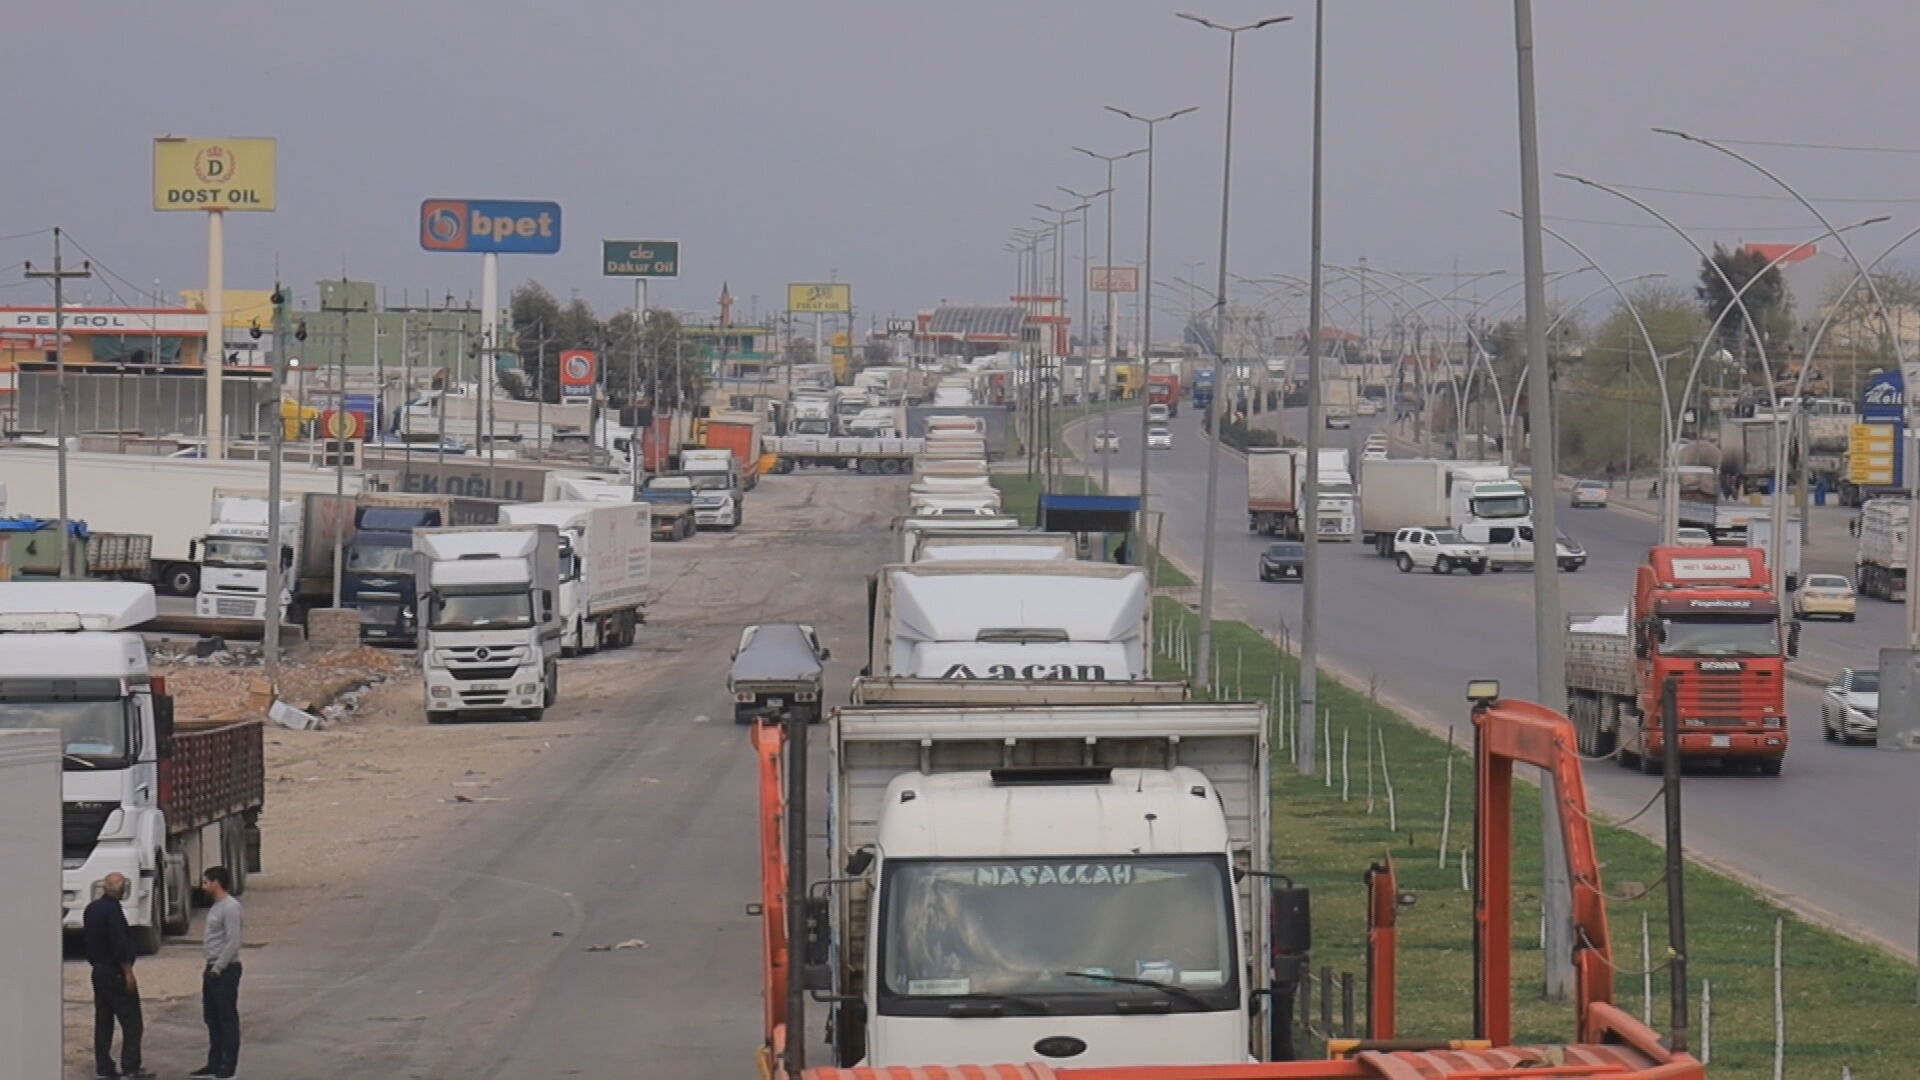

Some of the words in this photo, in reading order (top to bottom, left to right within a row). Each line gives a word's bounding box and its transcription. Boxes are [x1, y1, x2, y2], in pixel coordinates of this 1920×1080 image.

[208, 159, 223, 176] D
[168, 189, 221, 203] DOST
[228, 189, 261, 203] OIL
[471, 209, 552, 243] bpet
[607, 259, 651, 273] Dakur
[655, 260, 675, 273] Oil
